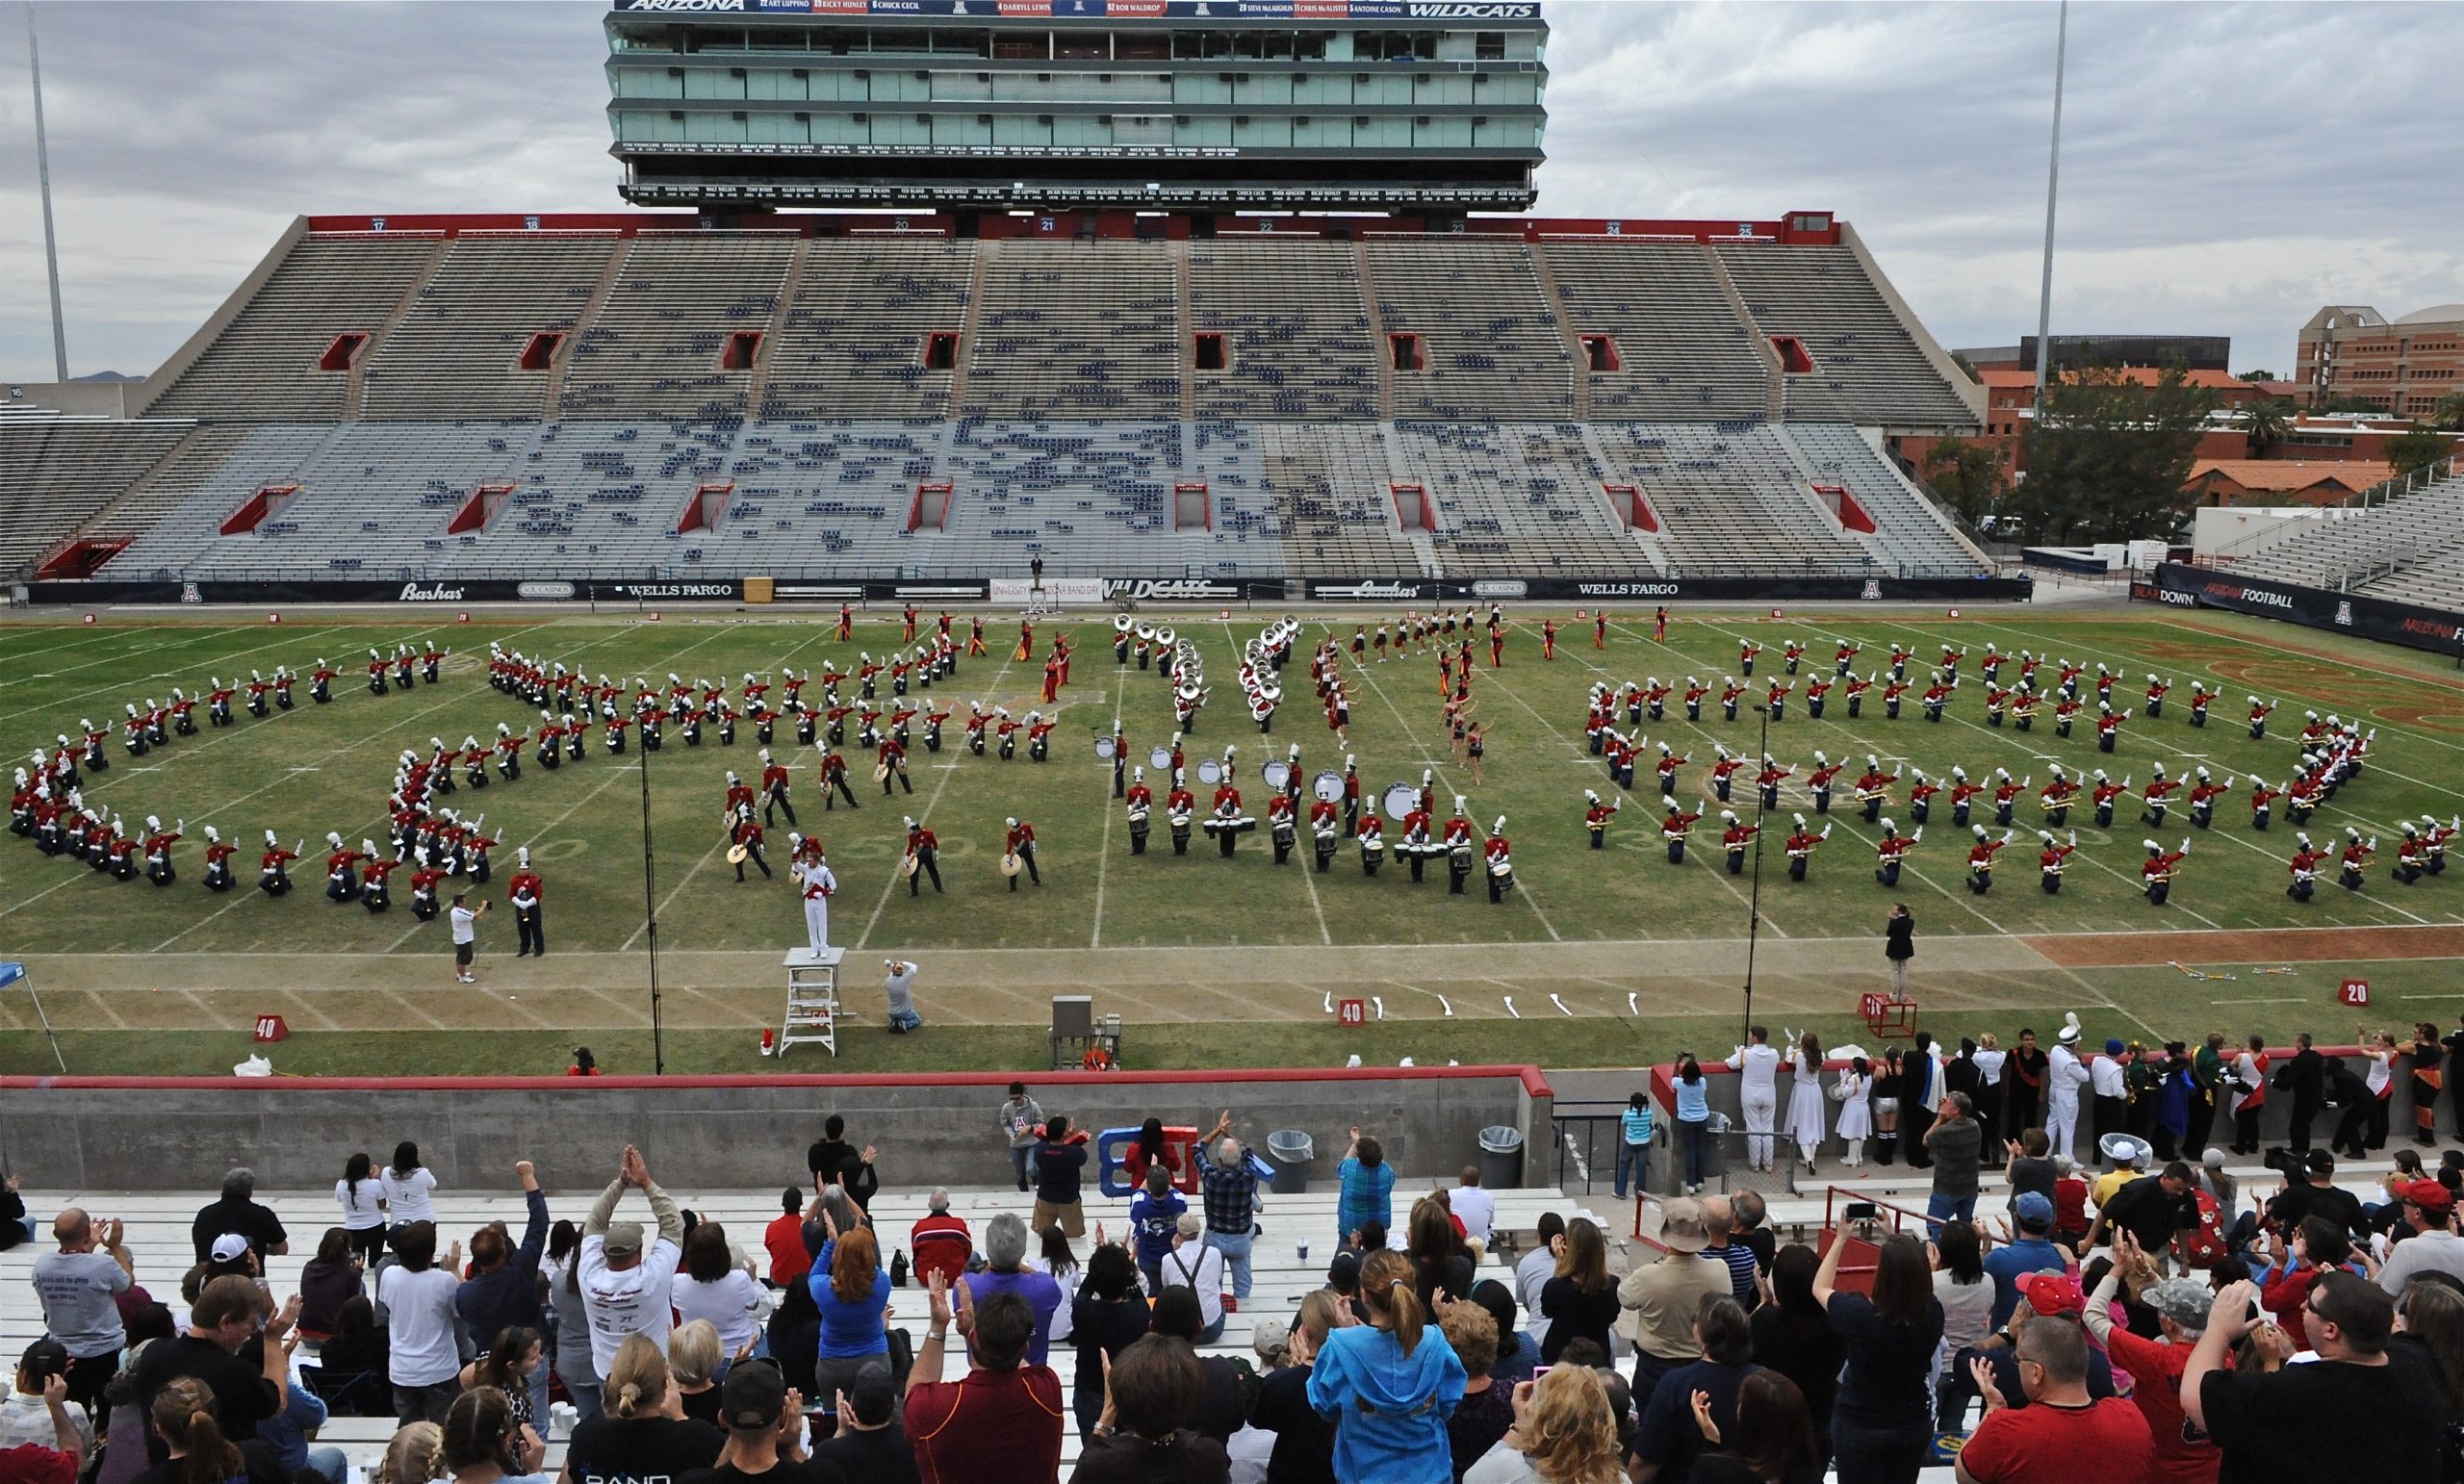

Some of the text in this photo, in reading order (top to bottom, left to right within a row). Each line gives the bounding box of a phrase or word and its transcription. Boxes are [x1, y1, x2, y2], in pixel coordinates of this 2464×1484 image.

[628, 0, 744, 11] ARIZONA
[1410, 4, 1534, 17] WILDCATS
[373, 221, 384, 231] 17
[526, 220, 538, 229] 18
[895, 221, 909, 230] 20
[1041, 221, 1053, 231] 21
[12, 388, 22, 397] 16
[399, 582, 465, 601] Bashas'
[628, 585, 732, 596] WELLS FARGO
[993, 585, 1026, 595] UNIVERSITY
[1067, 585, 1086, 594] BAND
[1087, 585, 1099, 594] DAY
[1578, 584, 1679, 595] WELLS FARGO
[2242, 588, 2293, 608] FOOTBALL
[2402, 617, 2454, 637] ARIZONA
[2348, 985, 2367, 1002] 20
[1343, 1004, 1360, 1021] 40
[257, 1019, 275, 1038] 40
